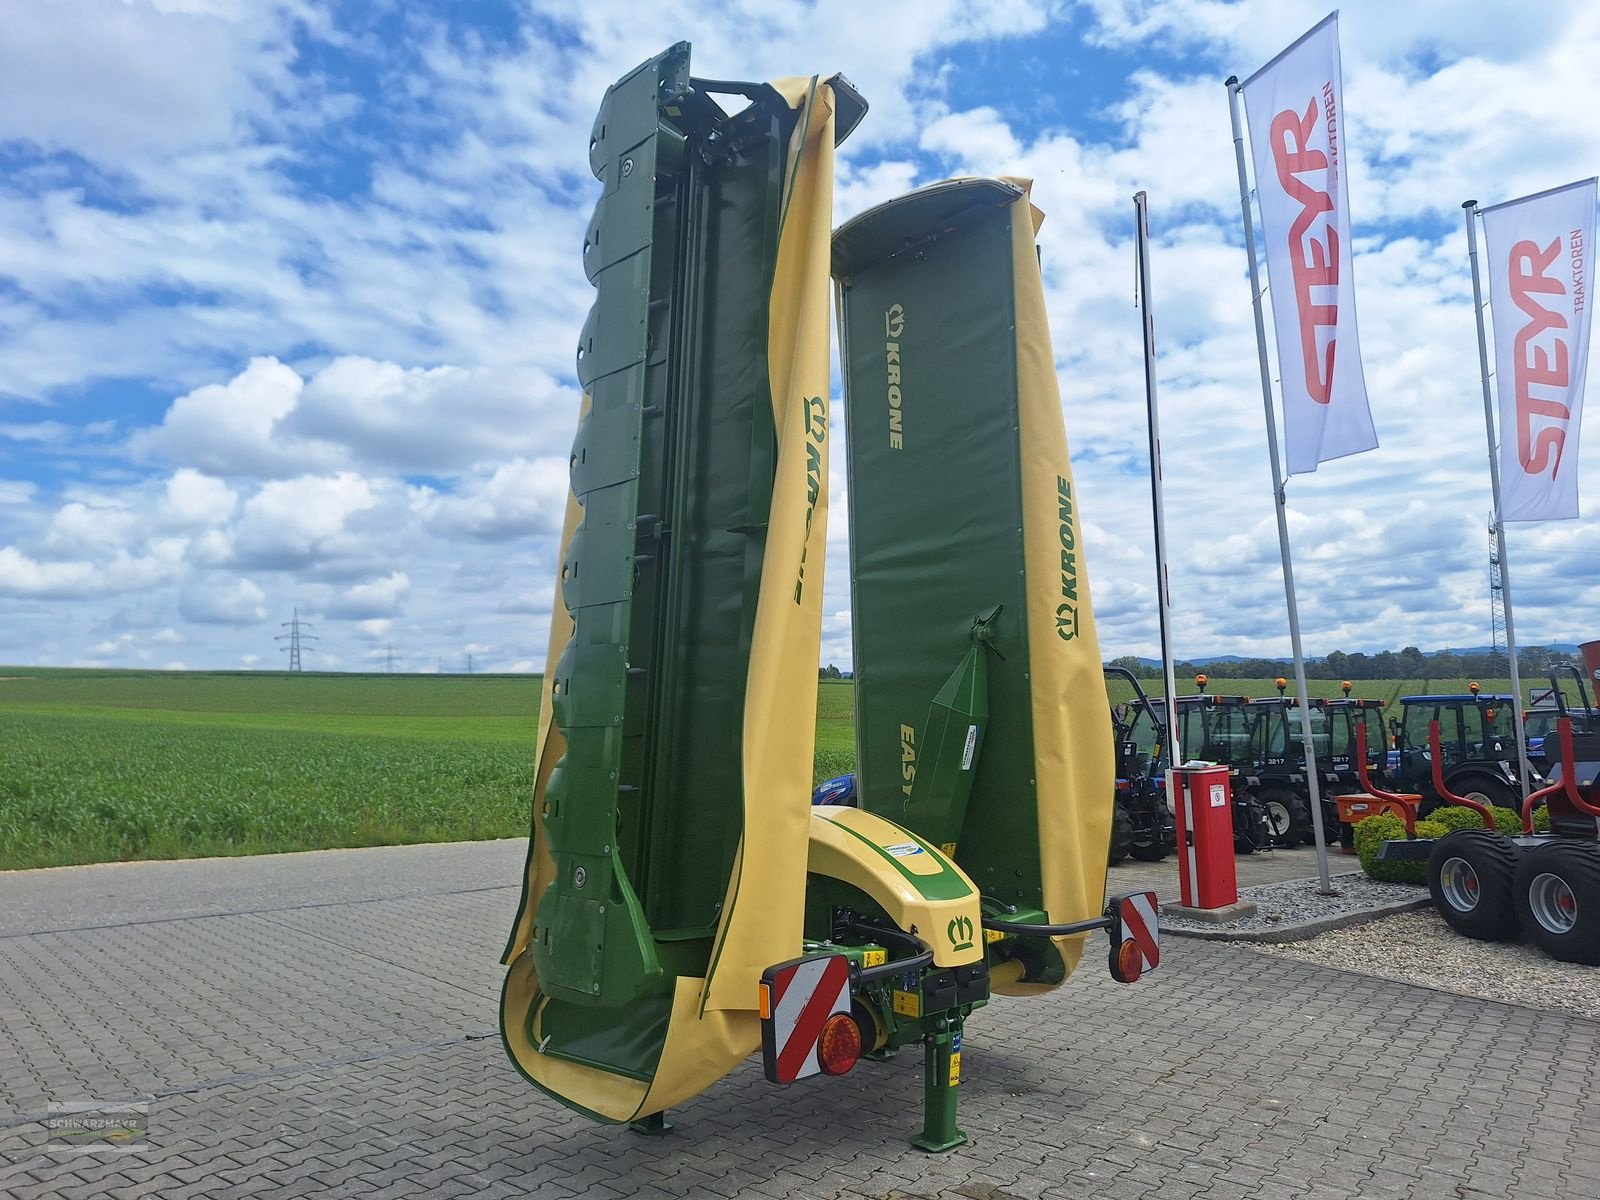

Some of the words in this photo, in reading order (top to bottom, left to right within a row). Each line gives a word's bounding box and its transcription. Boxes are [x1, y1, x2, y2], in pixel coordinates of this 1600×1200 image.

[1269, 96, 1339, 404] STEYR
[1573, 228, 1584, 315] TRAKTOREN
[886, 342, 903, 451] KRONE
[1509, 236, 1570, 481] STEYR
[1056, 475, 1078, 602] KRONE
